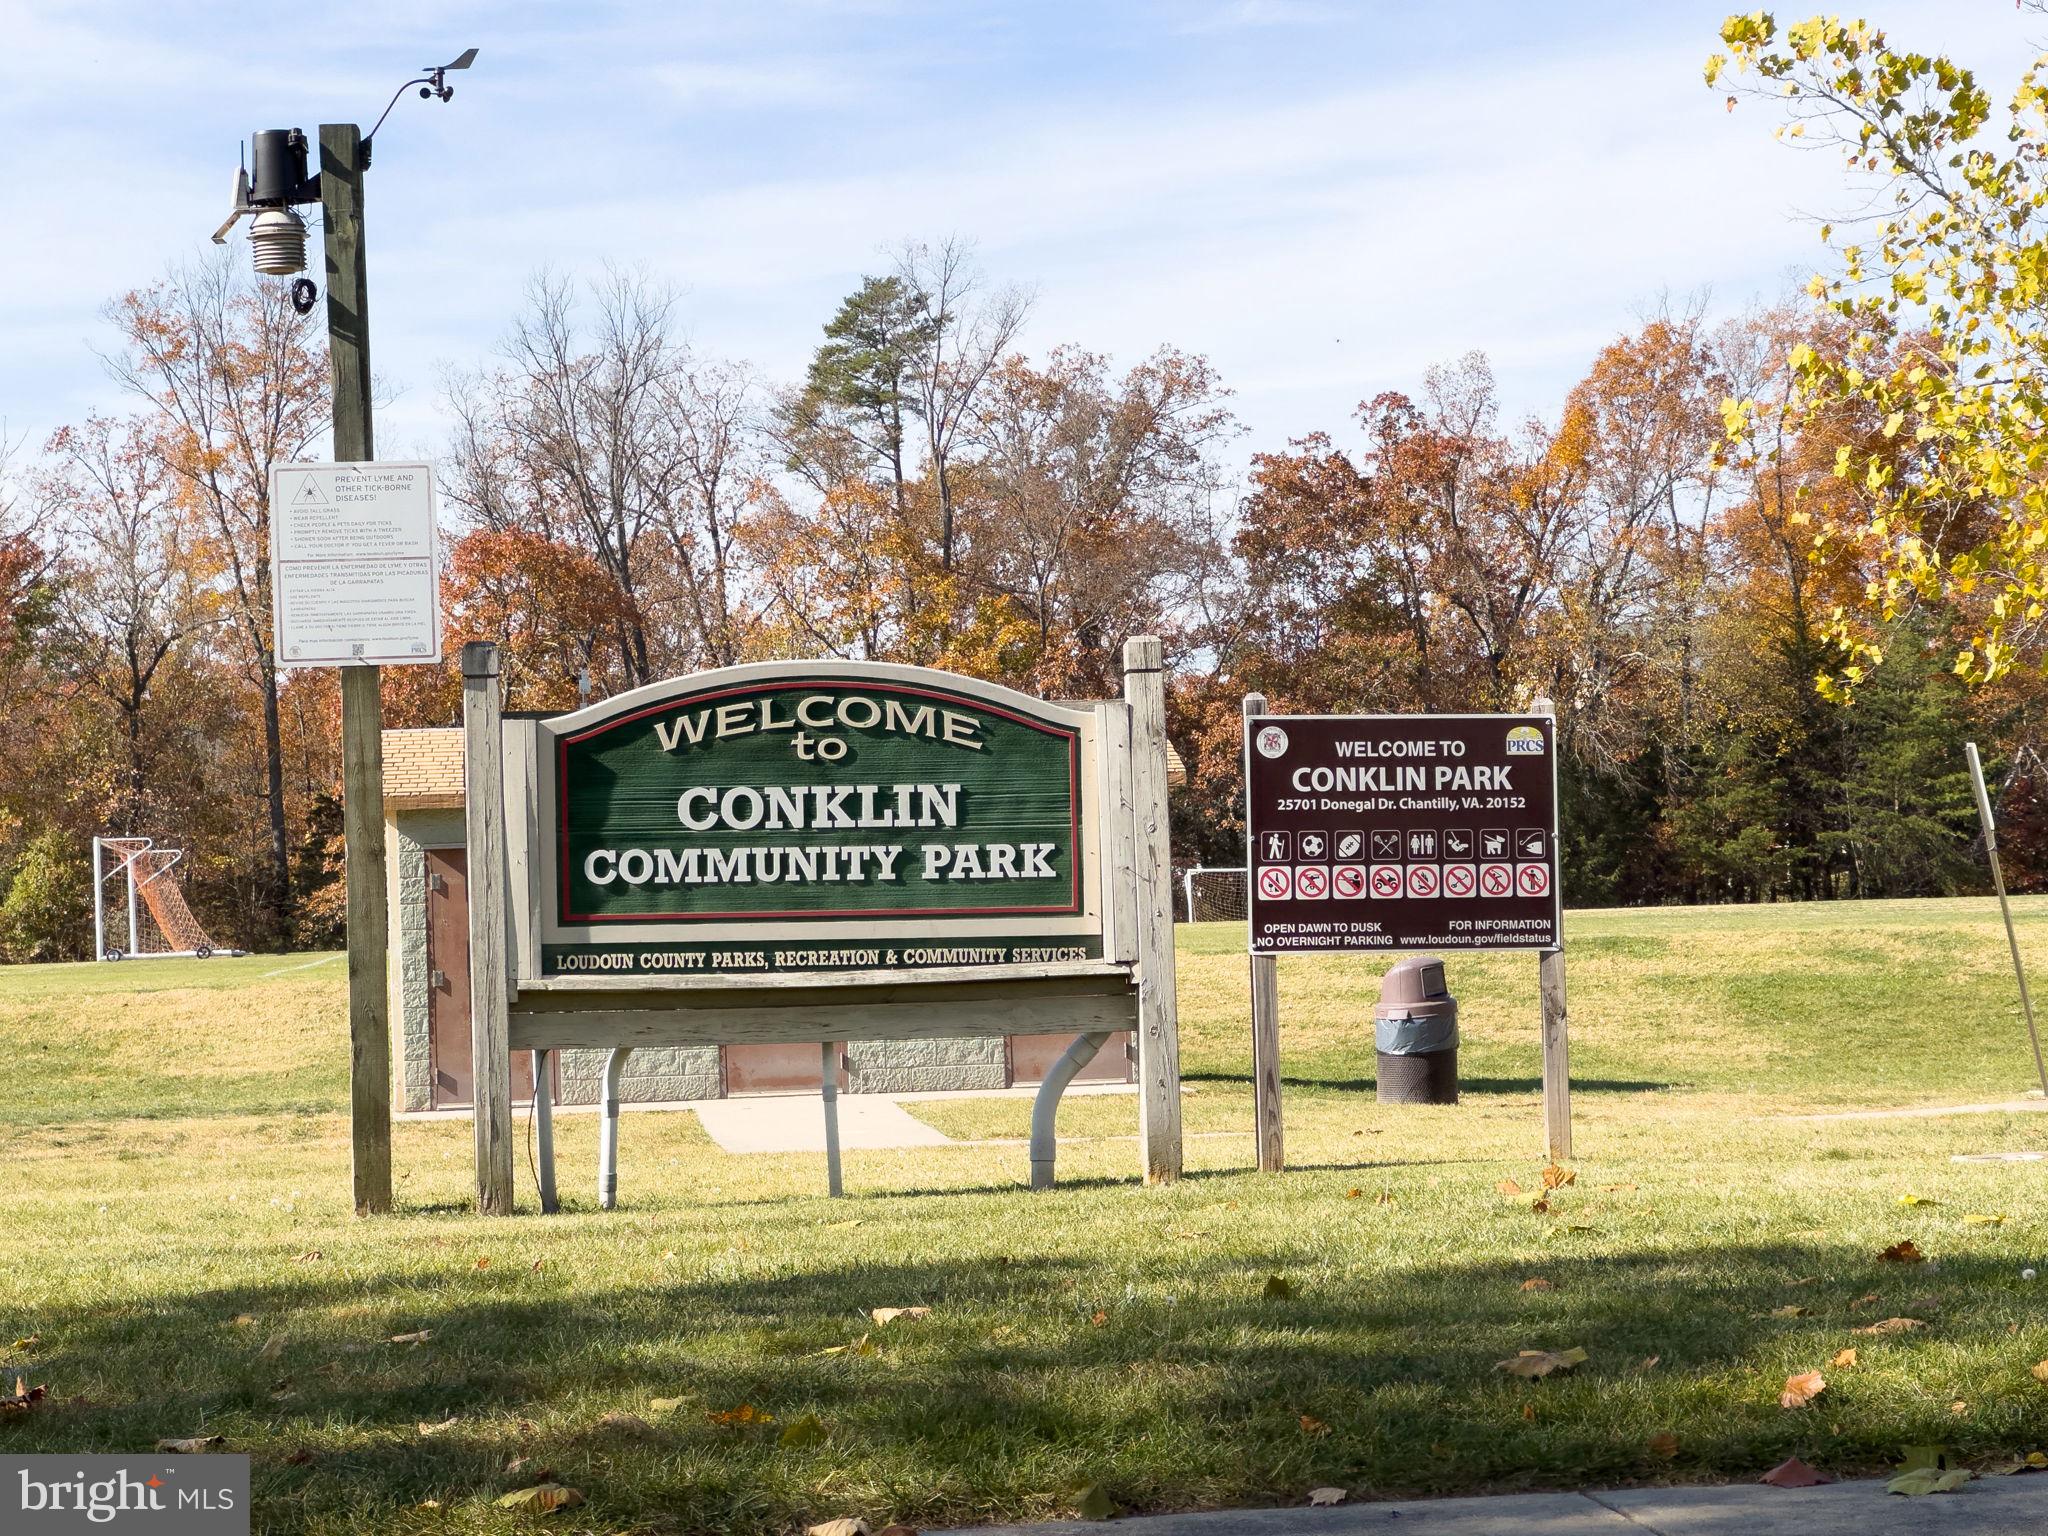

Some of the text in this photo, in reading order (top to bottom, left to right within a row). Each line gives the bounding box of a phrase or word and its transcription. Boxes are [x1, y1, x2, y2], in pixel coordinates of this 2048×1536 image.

[364, 484, 412, 492] TICK-BORNE
[336, 494, 377, 502] DISEASES!
[654, 695, 984, 752] WELCOME
[791, 732, 848, 760] to
[1335, 741, 1466, 758] WELCOME TO
[1508, 740, 1544, 752] PRCS
[1292, 766, 1512, 792] CONKLIN PARK
[677, 783, 961, 831] CONKLIN
[1278, 797, 1526, 813] 25701 Donegal Dr. Chantilly, VA. 20152
[584, 843, 1056, 886] COMMUNITY PARK
[1264, 922, 1382, 934] OPEN DAWN TO DUSK
[1449, 920, 1550, 930] FOR INFORMATION
[1256, 935, 1393, 947] NO OVERNIGHT PARKING
[1400, 933, 1551, 946] www.loudoun.gov/fieldstatus
[557, 947, 1087, 970] LOUDOUN COUNTY PARKS, RECREATION & COMMUNITY SERVICES
